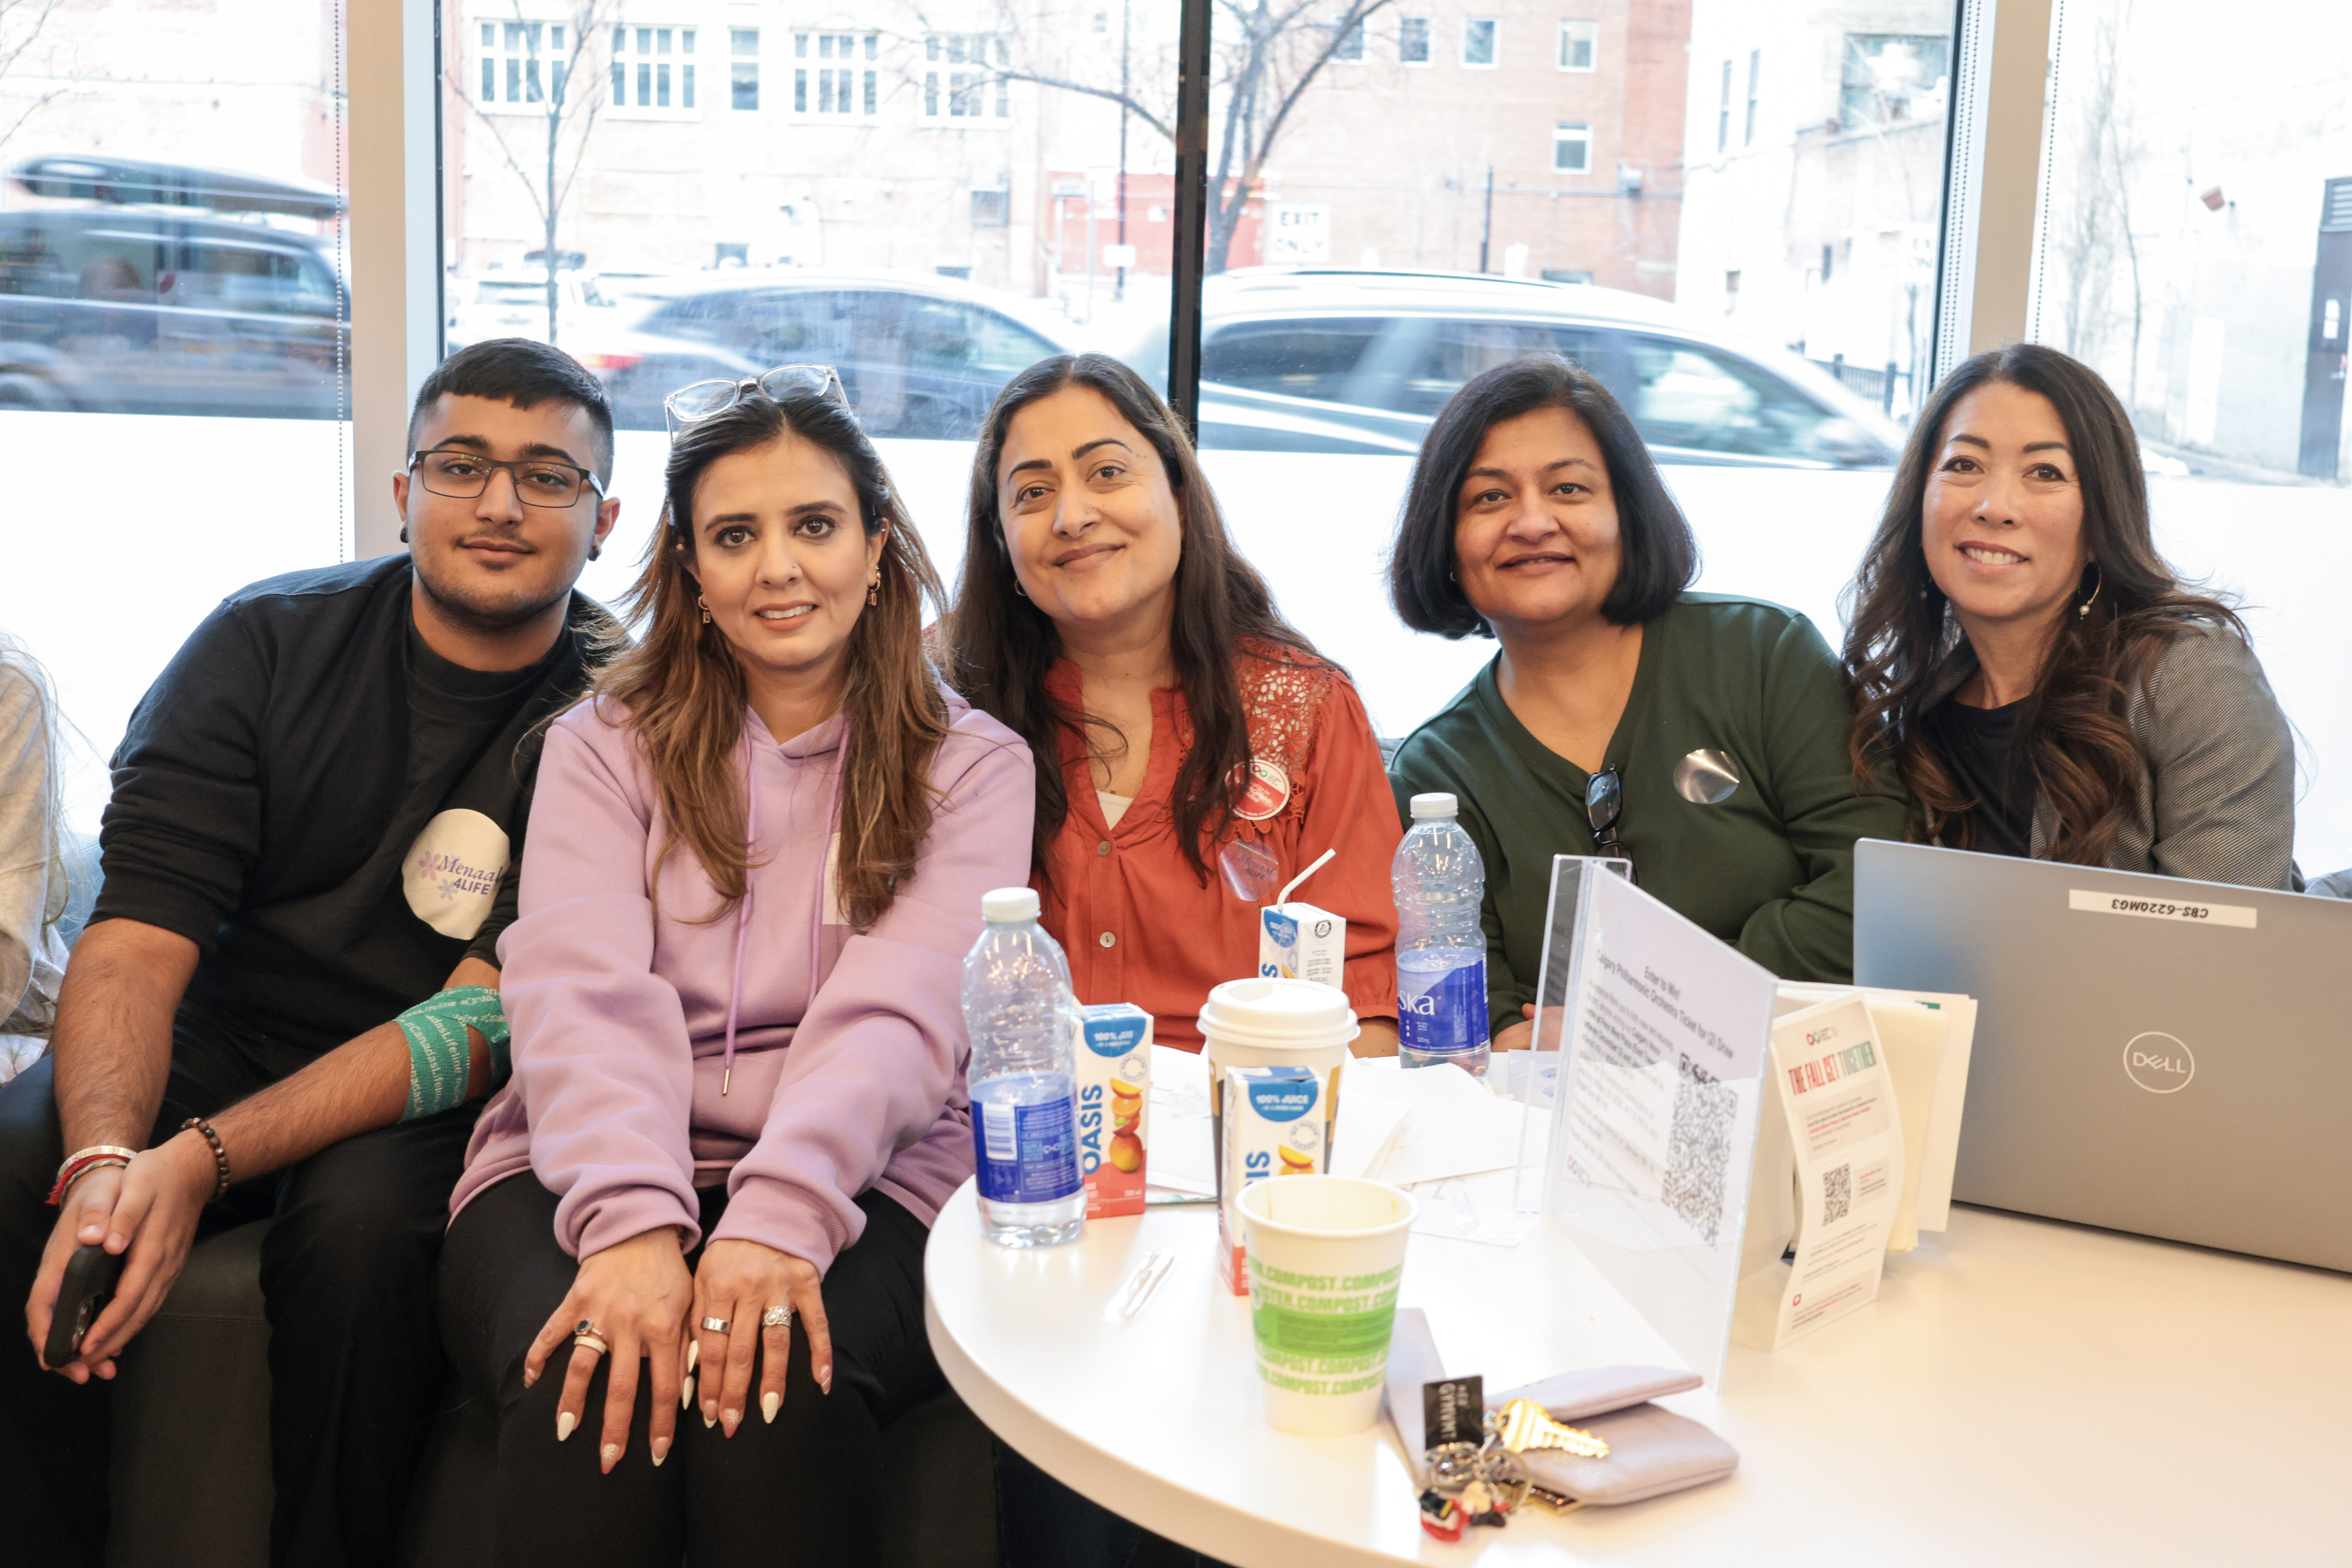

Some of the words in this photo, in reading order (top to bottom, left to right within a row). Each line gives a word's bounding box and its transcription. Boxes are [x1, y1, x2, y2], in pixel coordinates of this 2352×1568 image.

[436, 855, 504, 882] Menaal
[453, 878, 491, 895] 4LIFE
[1397, 990, 1436, 1015] ska
[2132, 1052, 2187, 1074] DELL
[1081, 1084, 1102, 1174] OASIS
